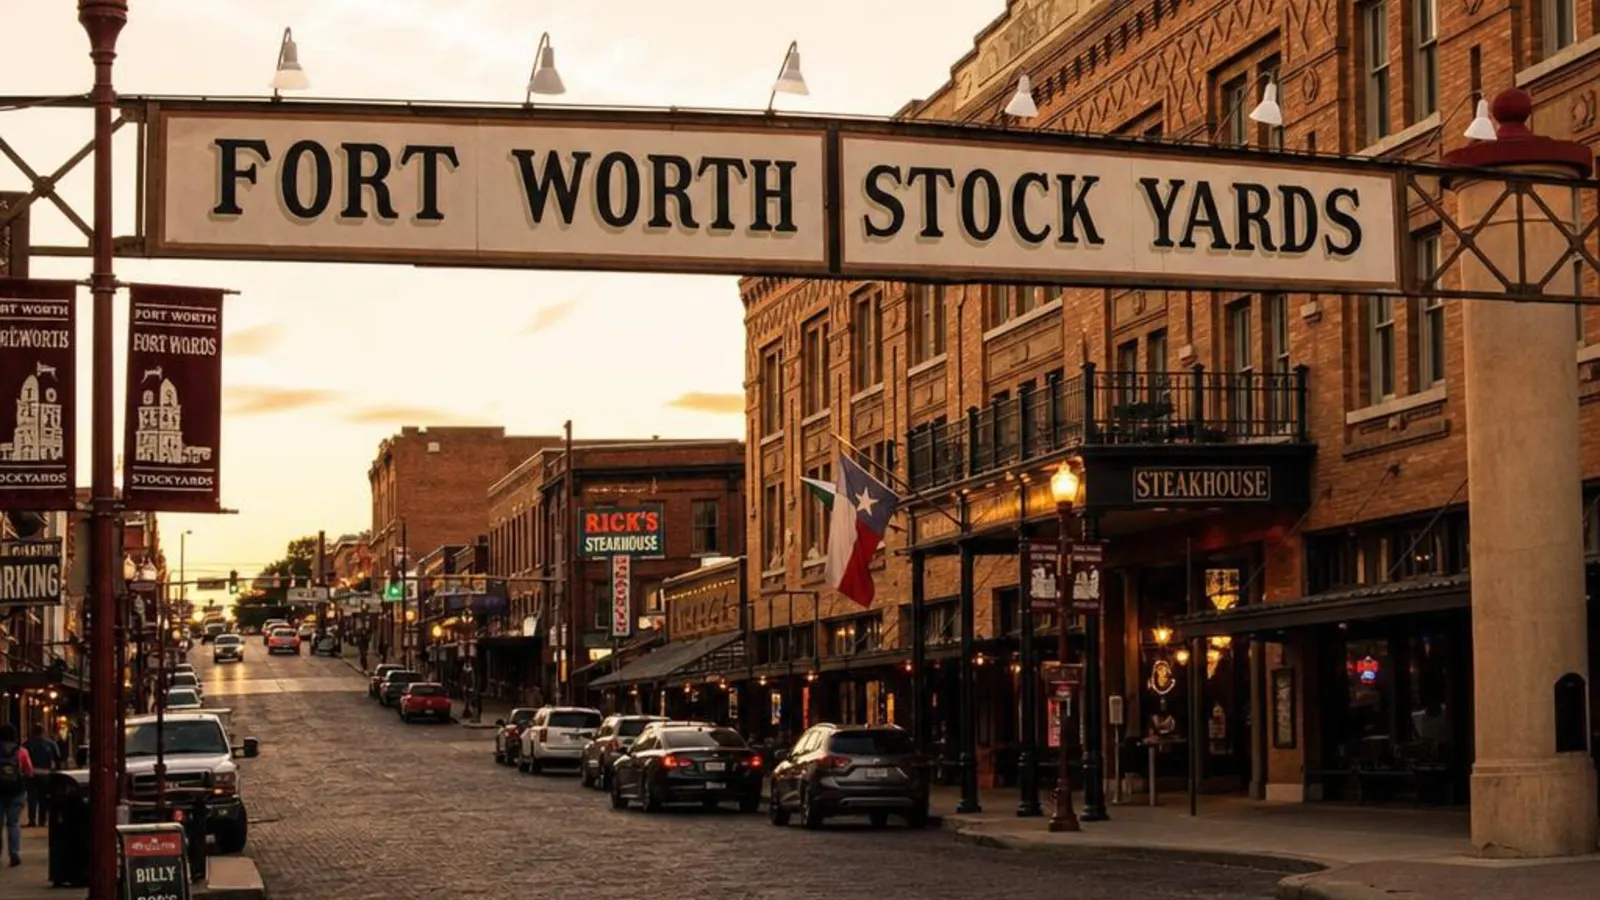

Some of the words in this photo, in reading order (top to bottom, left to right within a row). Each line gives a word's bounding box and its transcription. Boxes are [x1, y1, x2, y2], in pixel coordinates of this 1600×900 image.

[211, 137, 461, 221] FORT
[509, 148, 799, 233] WORTH
[862, 164, 1106, 246] STOCK
[1138, 177, 1363, 257] YARDS
[21, 304, 69, 315] WORTH
[171, 311, 217, 323] WORTH
[132, 474, 214, 487] STOCKYARDS
[1136, 470, 1267, 498] STEAKHOUSE
[584, 511, 660, 533] RICK'S
[584, 535, 659, 552] STEAKHOUSE
[0, 563, 59, 600] RKING
[136, 866, 177, 883] BILLY
